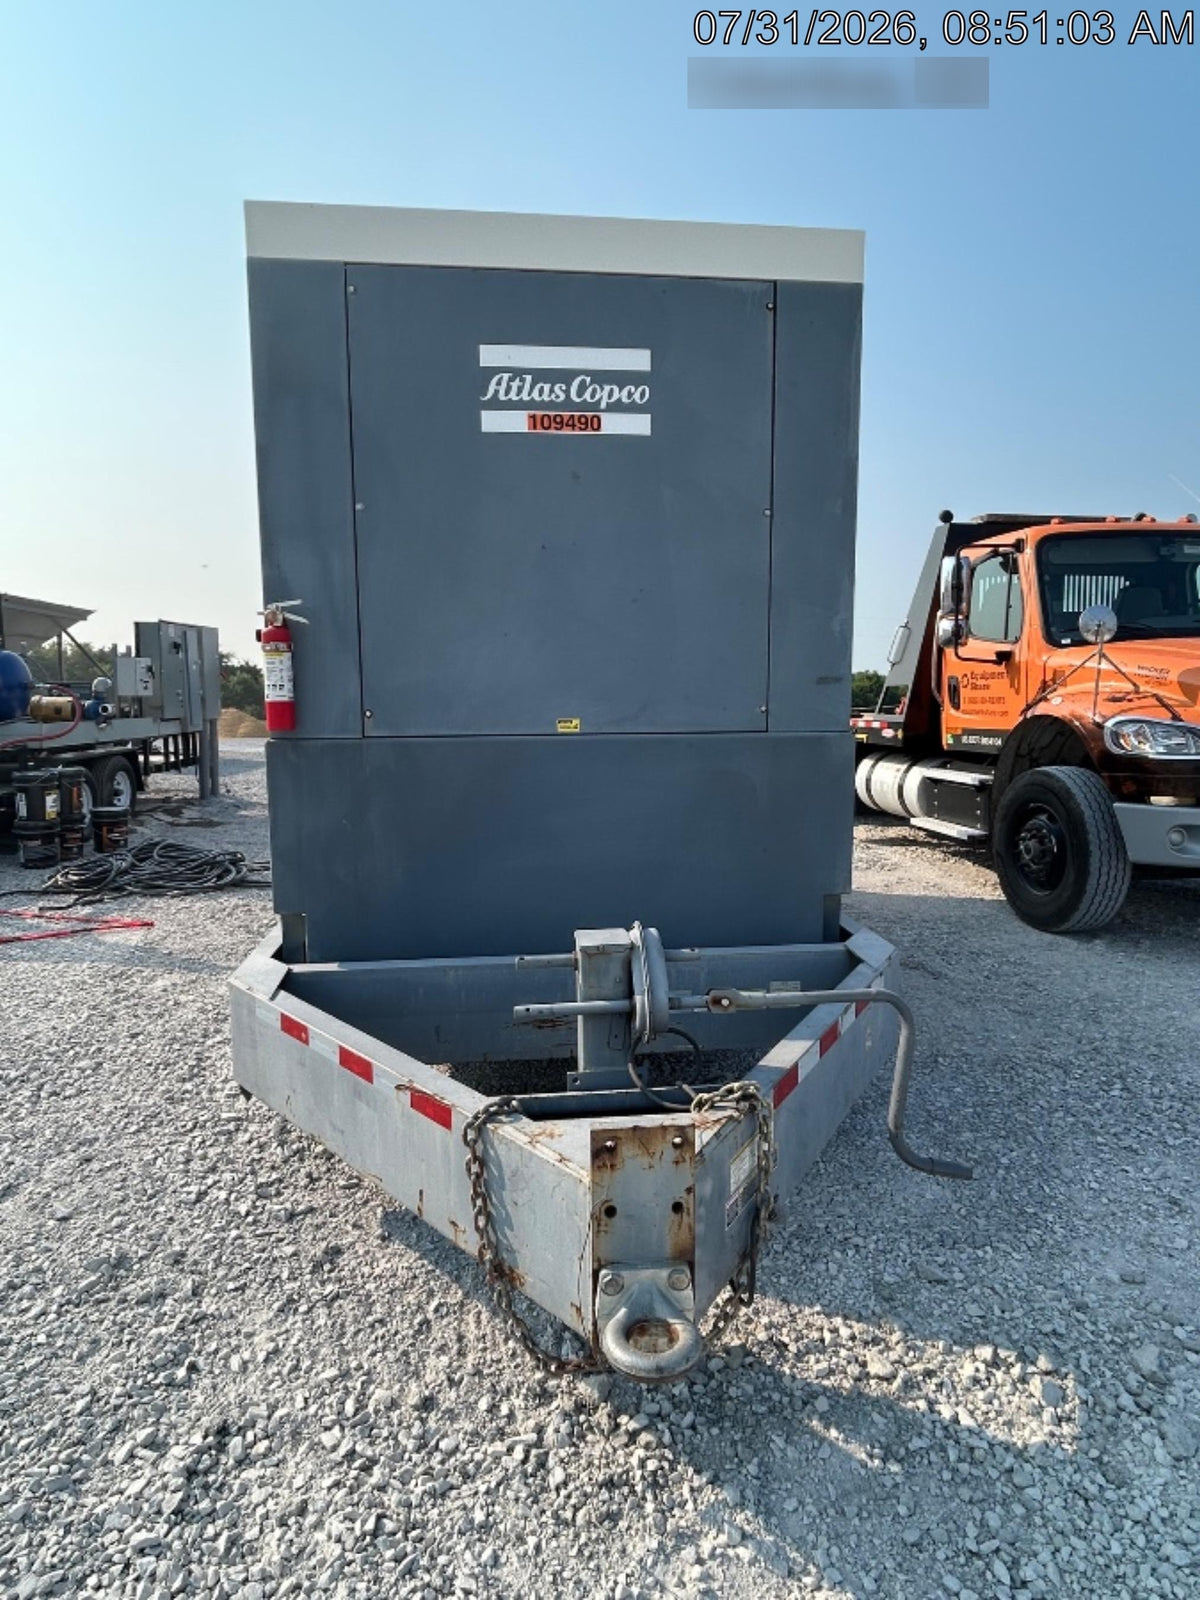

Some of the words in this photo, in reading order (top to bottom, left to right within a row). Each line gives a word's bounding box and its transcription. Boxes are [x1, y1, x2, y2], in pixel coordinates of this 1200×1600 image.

[480, 373, 566, 402] Atlas
[570, 375, 650, 409] Copco
[528, 413, 602, 431] 109490
